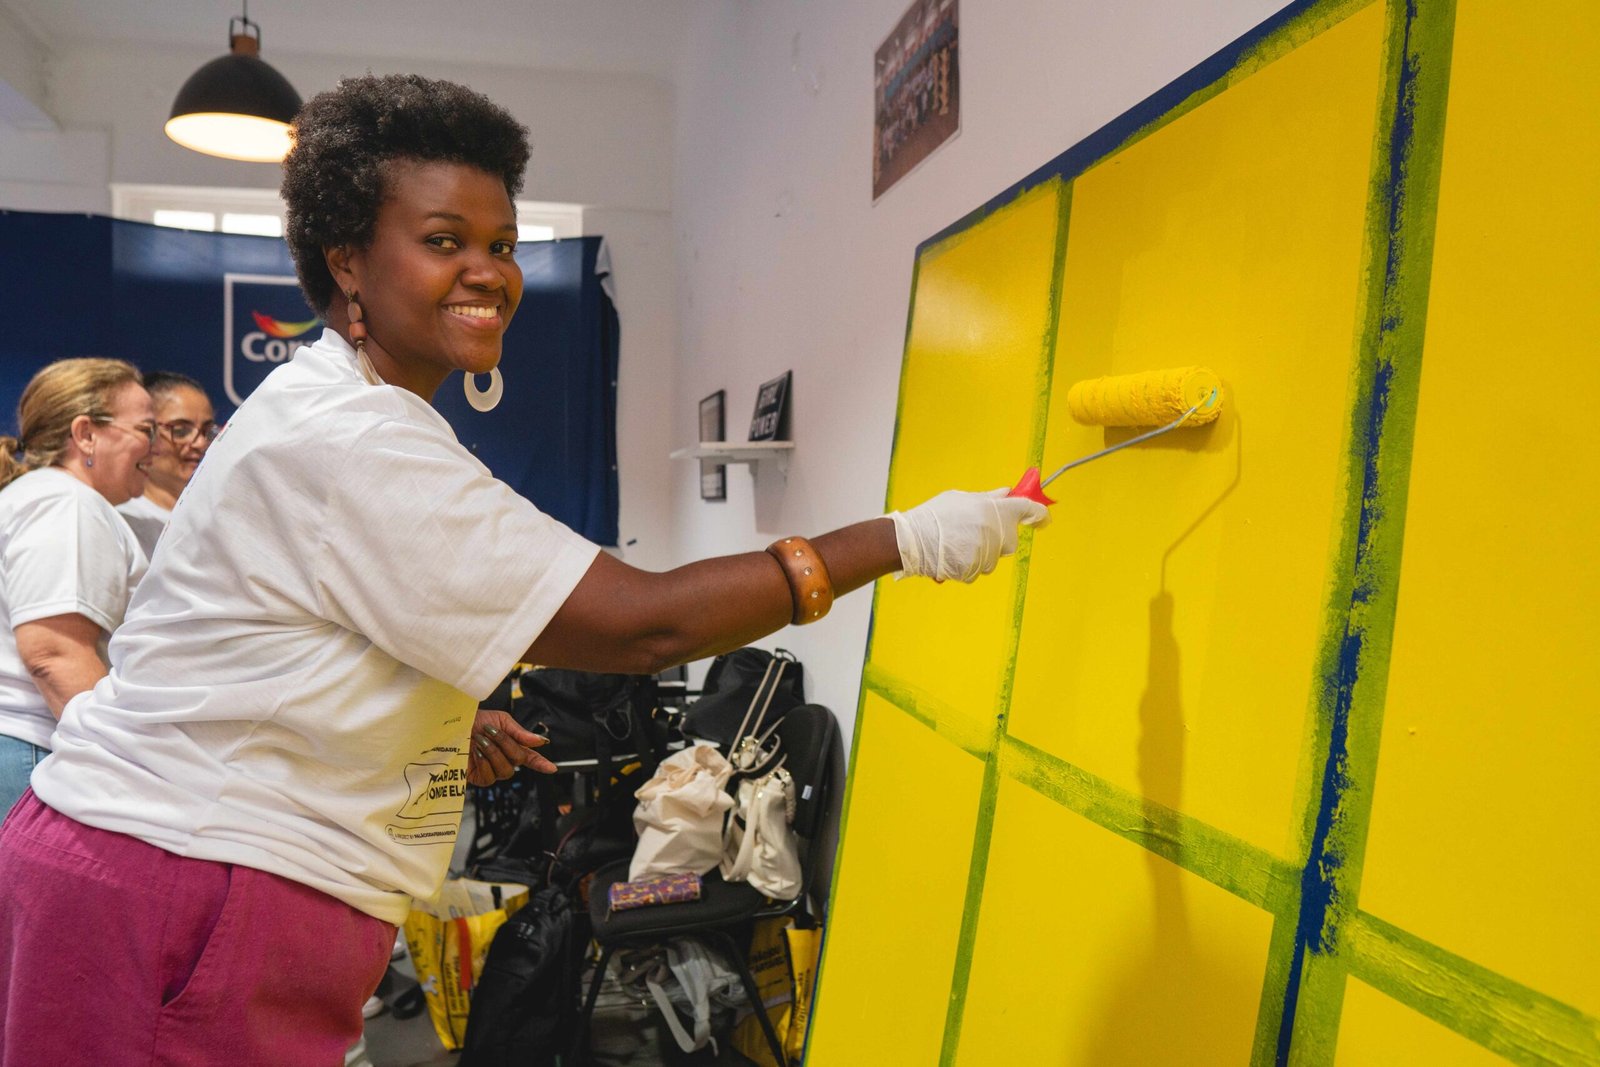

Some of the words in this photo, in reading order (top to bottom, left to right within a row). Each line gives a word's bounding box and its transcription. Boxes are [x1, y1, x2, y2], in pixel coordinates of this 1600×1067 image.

[242, 331, 313, 362] Cor
[758, 383, 779, 408] GIRL
[751, 411, 777, 437] POWER
